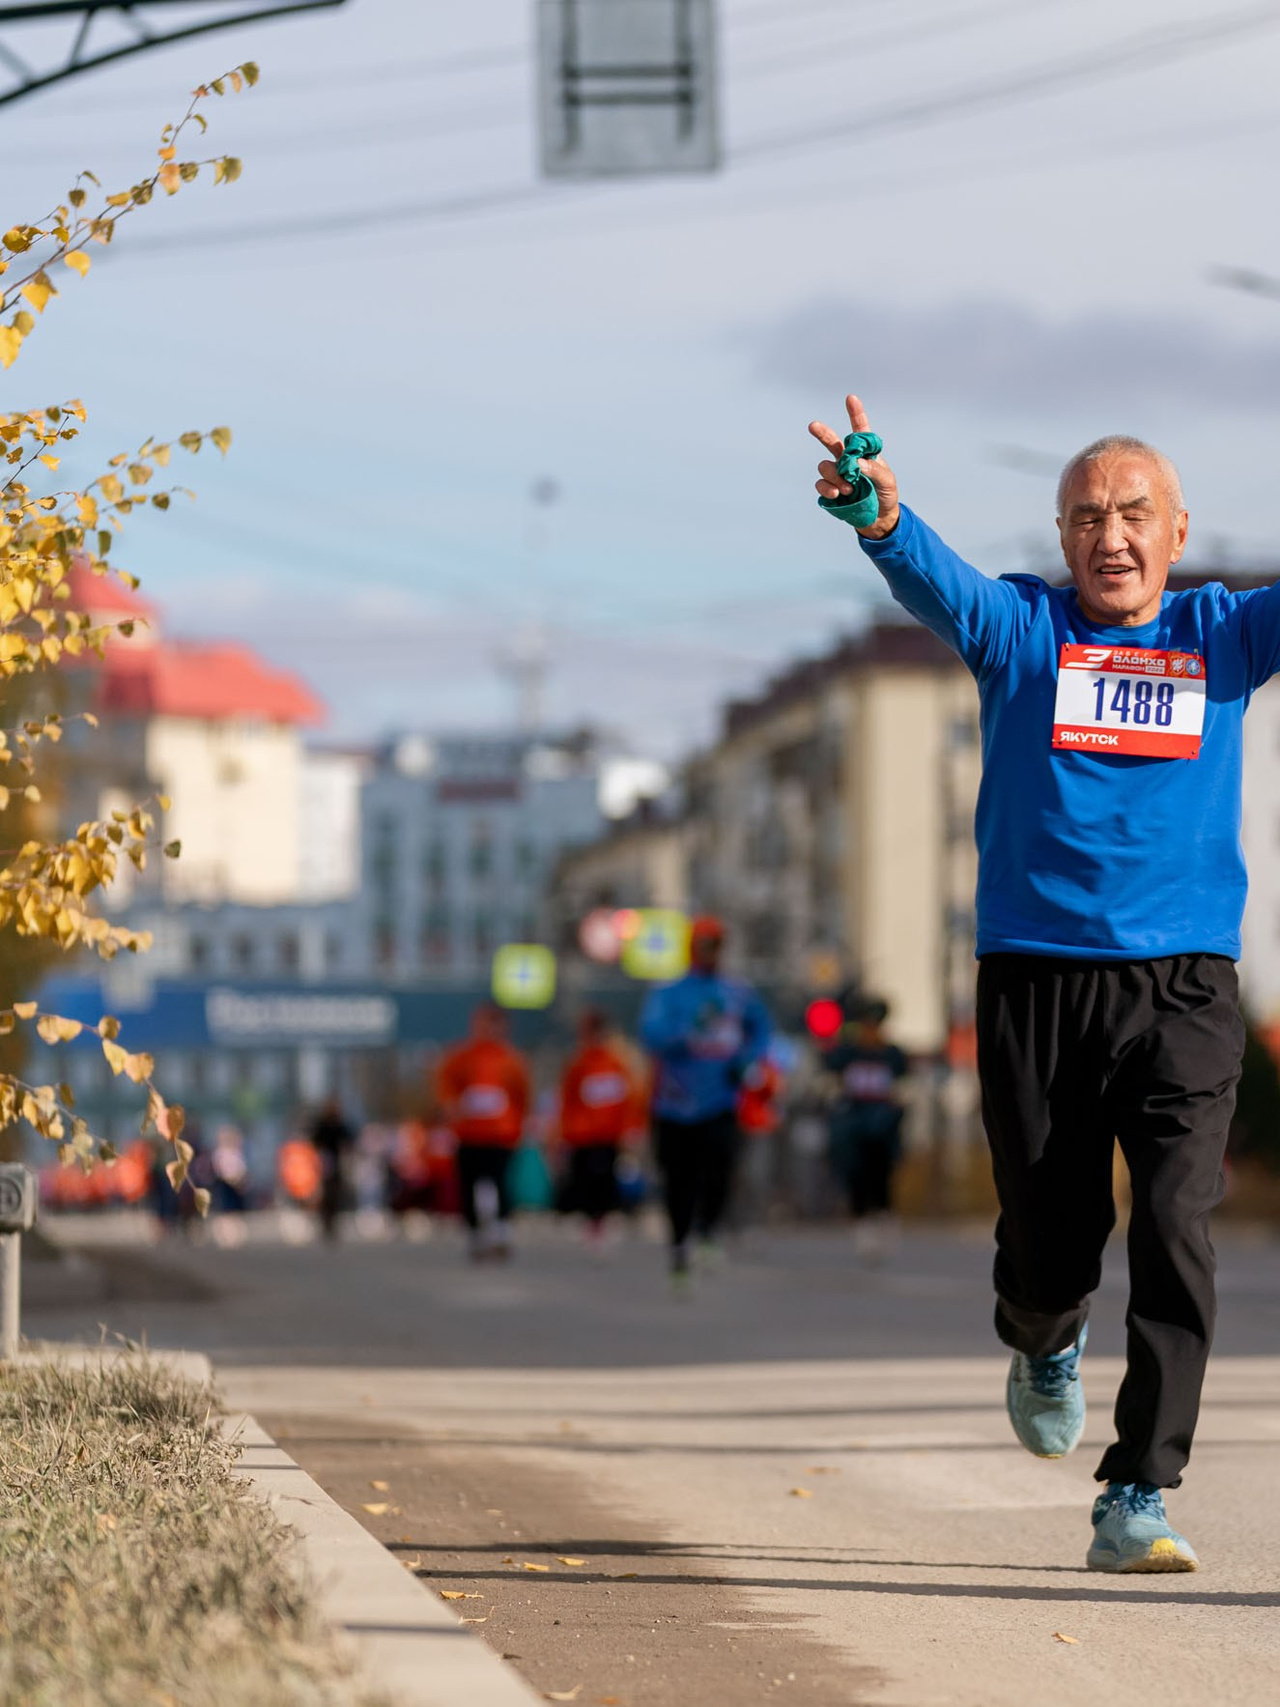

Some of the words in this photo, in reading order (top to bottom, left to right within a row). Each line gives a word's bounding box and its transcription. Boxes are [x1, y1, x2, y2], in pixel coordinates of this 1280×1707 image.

[1112, 655, 1166, 667] ОЛОНХО
[1093, 677, 1174, 726] 1488
[1060, 731, 1118, 746] ЯКУТСК
